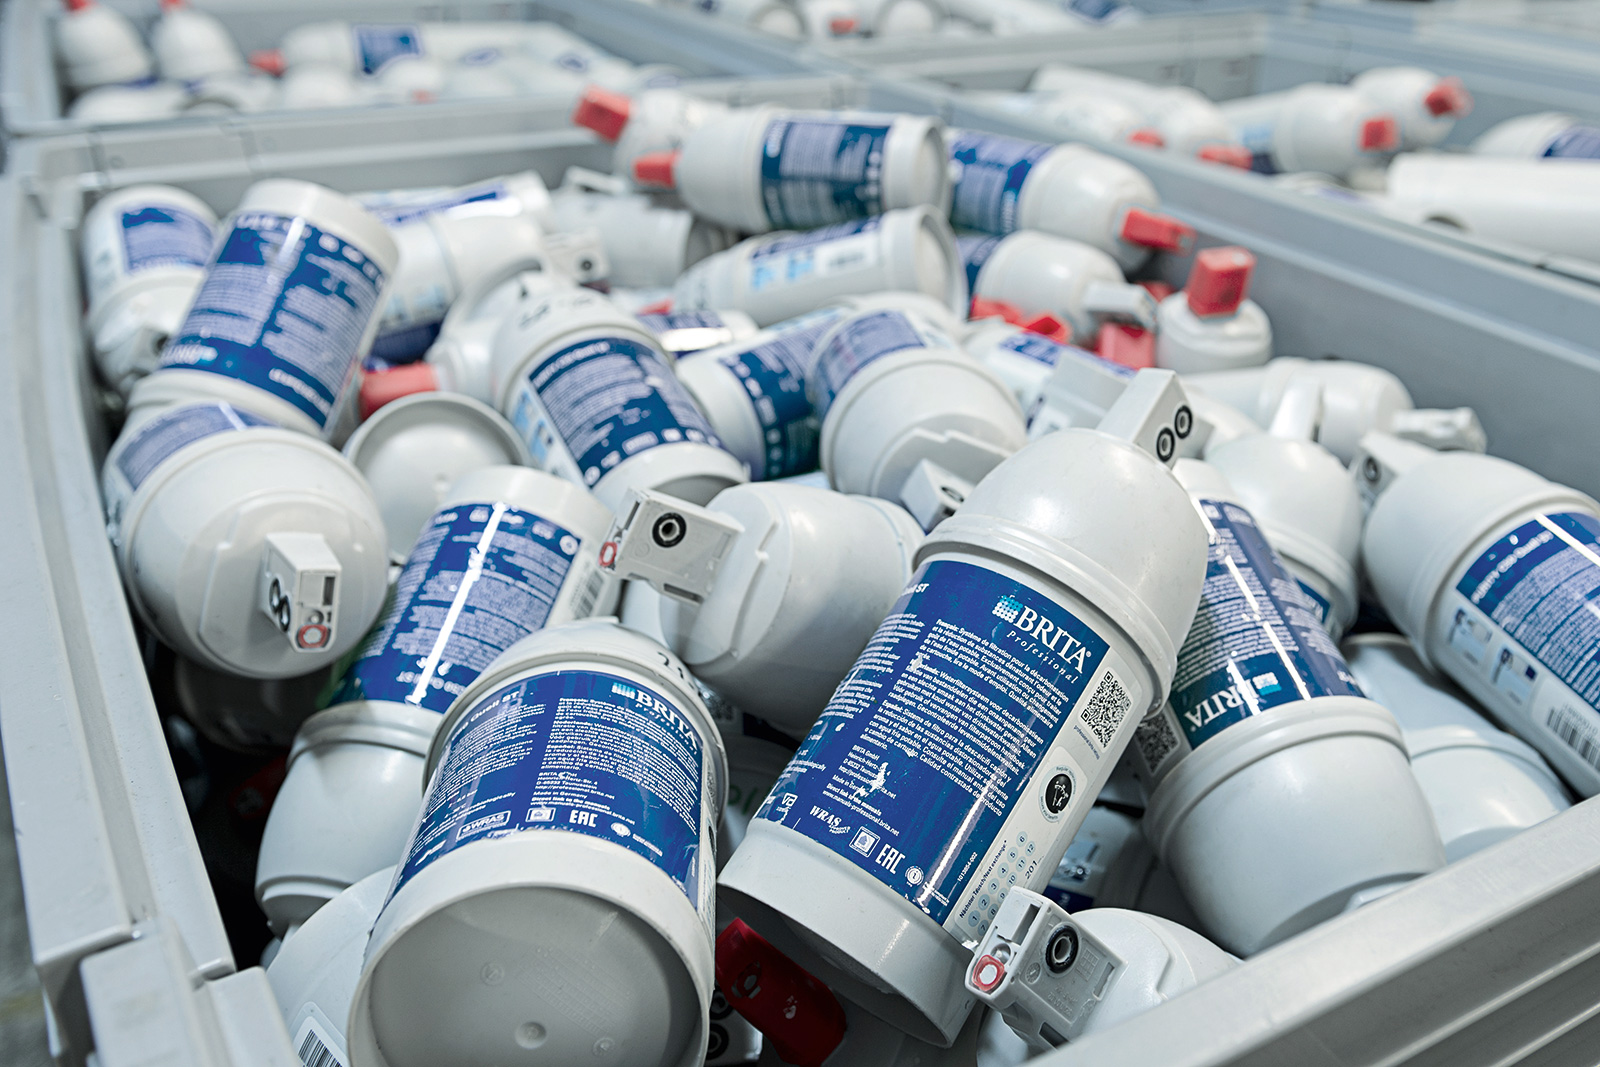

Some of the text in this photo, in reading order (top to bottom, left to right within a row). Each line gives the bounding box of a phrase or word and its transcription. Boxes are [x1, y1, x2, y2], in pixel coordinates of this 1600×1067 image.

[1013, 605, 1085, 674] BRITA
[1006, 631, 1079, 684] Professional
[1011, 657, 1025, 668] pour
[968, 667, 985, 679] mode
[980, 655, 1020, 682] Exclusivement
[980, 663, 998, 677] Avant
[945, 701, 962, 714] water
[961, 711, 973, 720] van
[989, 701, 1003, 712] voor
[636, 689, 698, 749] BRITA
[957, 718, 969, 728] van
[965, 703, 977, 713] het
[975, 709, 1005, 733] drinkwater
[927, 741, 942, 752] agua
[944, 732, 959, 743] para
[919, 753, 942, 771] Calidad
[940, 768, 973, 793] contrastada
[922, 746, 947, 765] Consulte
[952, 767, 975, 783] manual
[569, 809, 598, 827] EAC
[809, 805, 842, 826] WRAS
[875, 843, 906, 874] EAC
[1009, 875, 1015, 884] 10
[1027, 844, 1033, 853] 12
